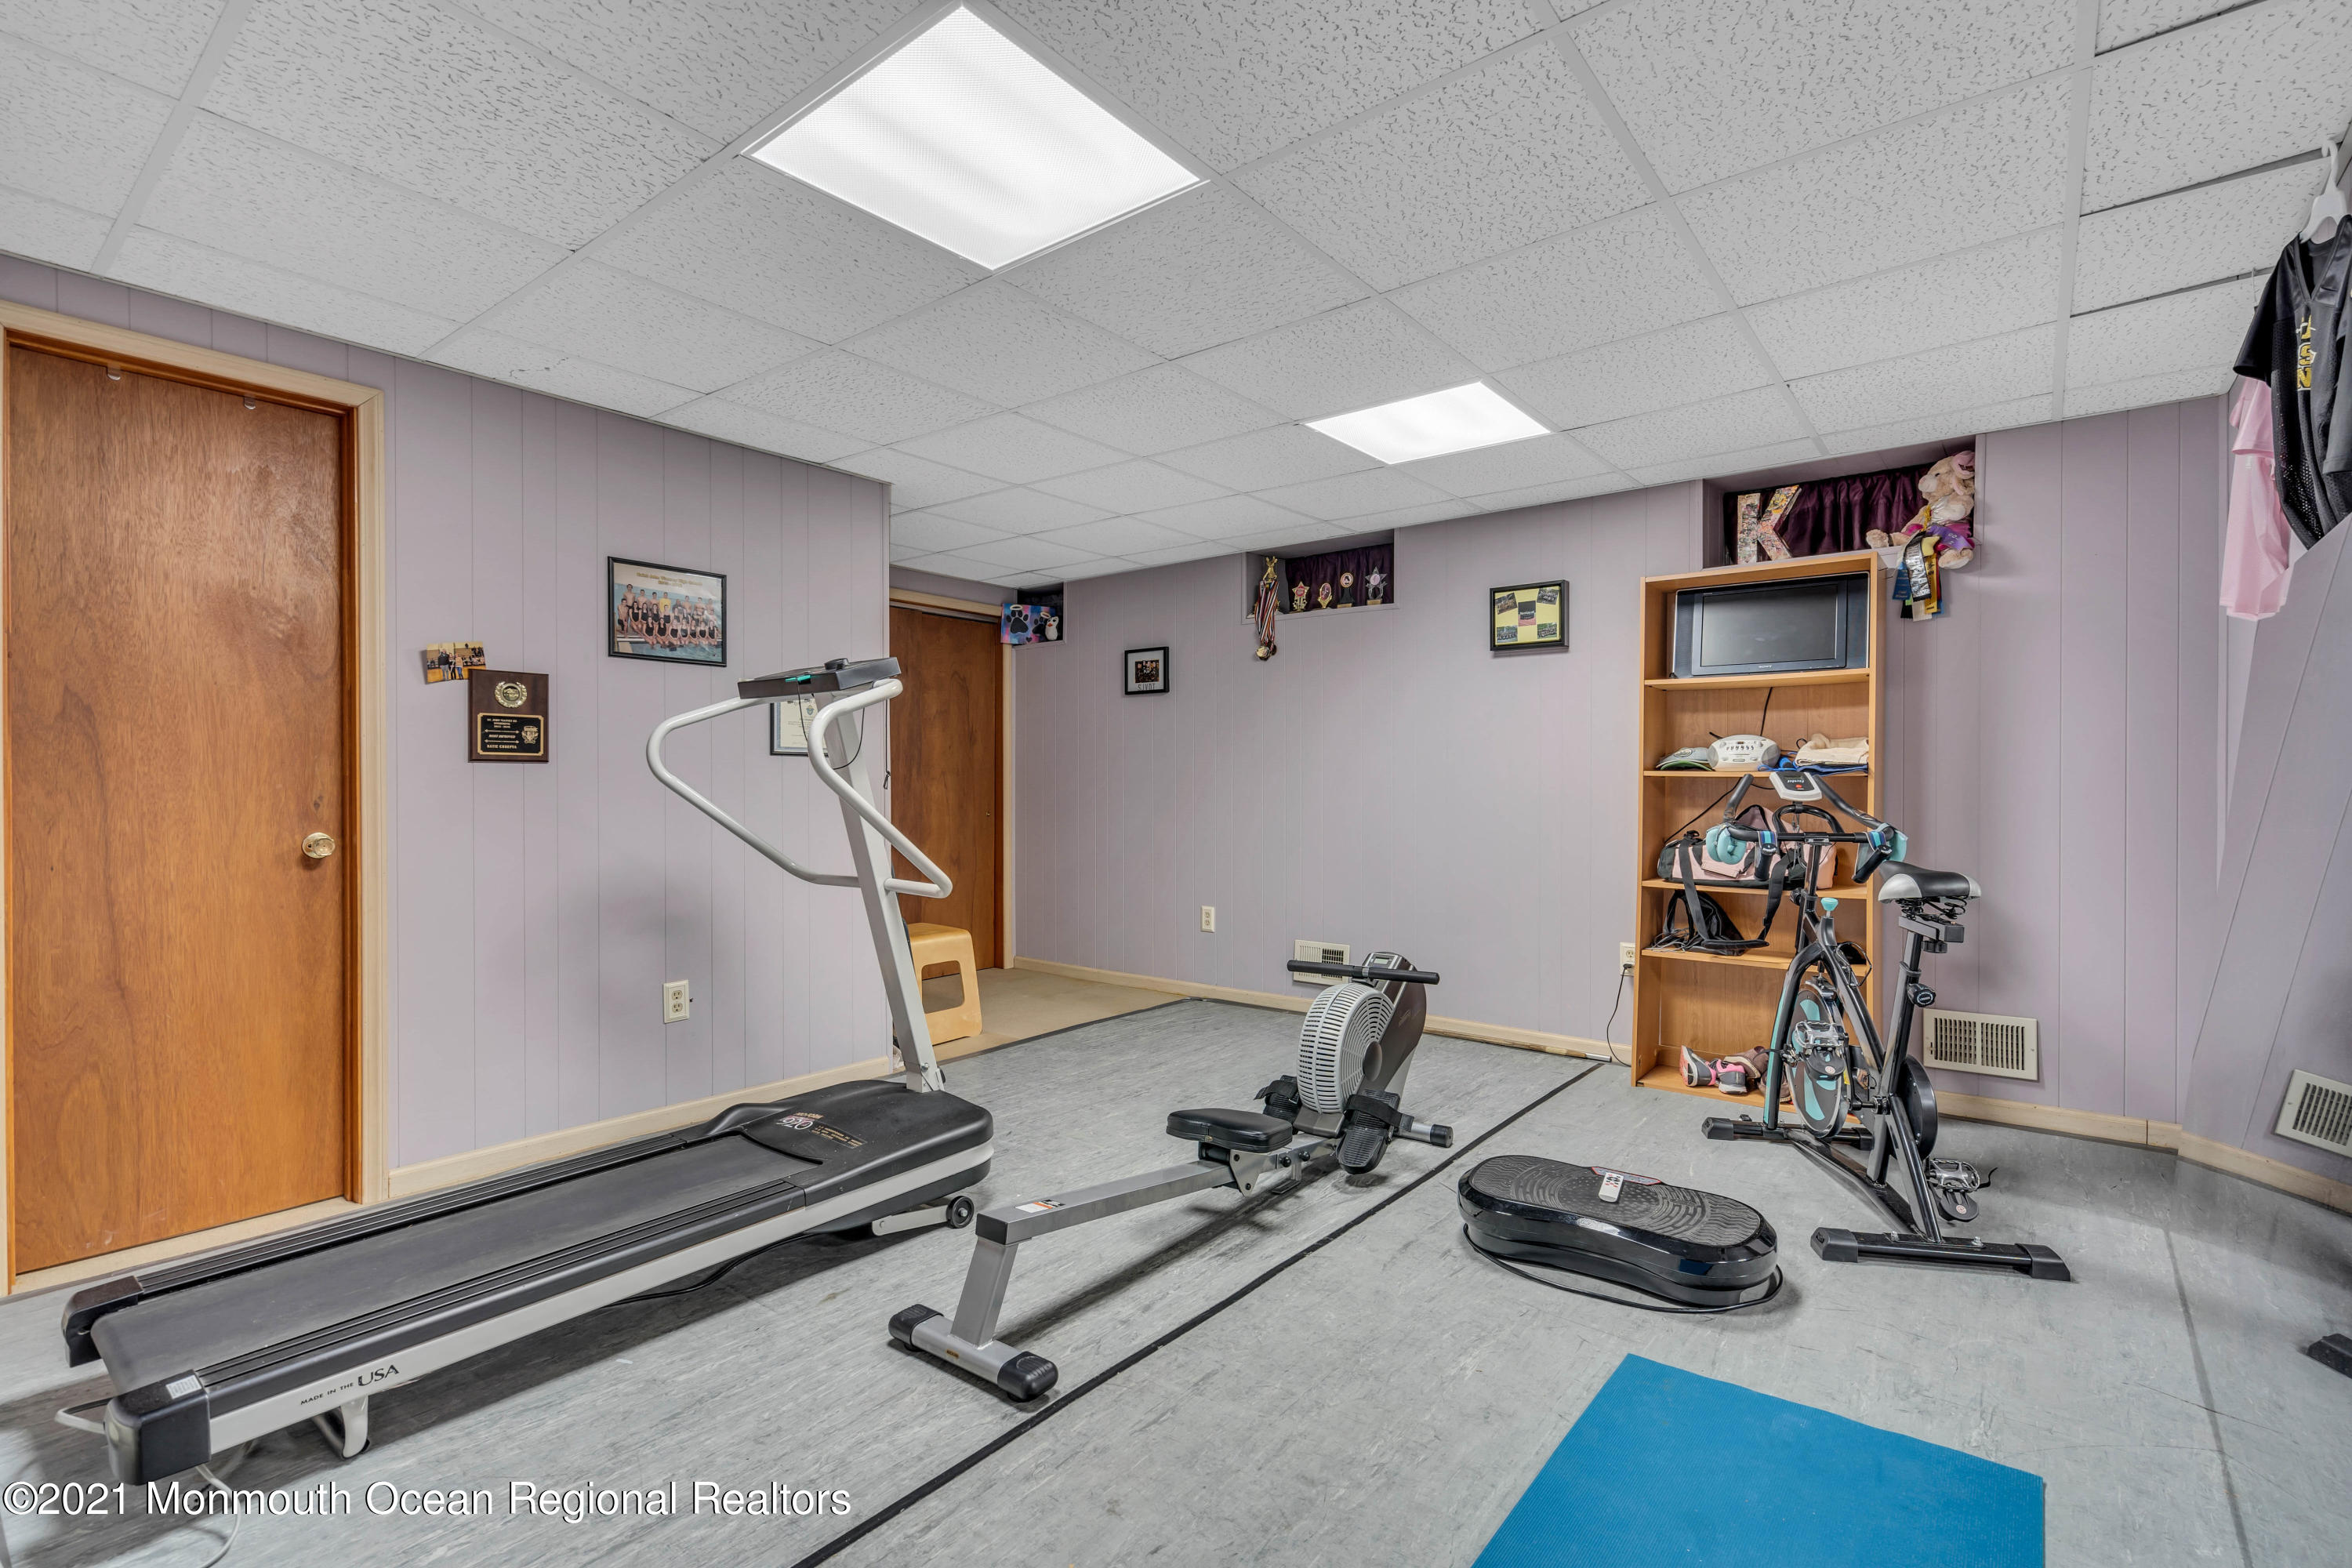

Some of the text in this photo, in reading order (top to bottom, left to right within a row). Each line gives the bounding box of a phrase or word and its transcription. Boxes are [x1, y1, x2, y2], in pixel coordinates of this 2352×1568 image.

[1737, 485, 1801, 564] K
[300, 1392, 324, 1406] MADE
[339, 1381, 354, 1391] THE
[358, 1364, 400, 1387] USA
